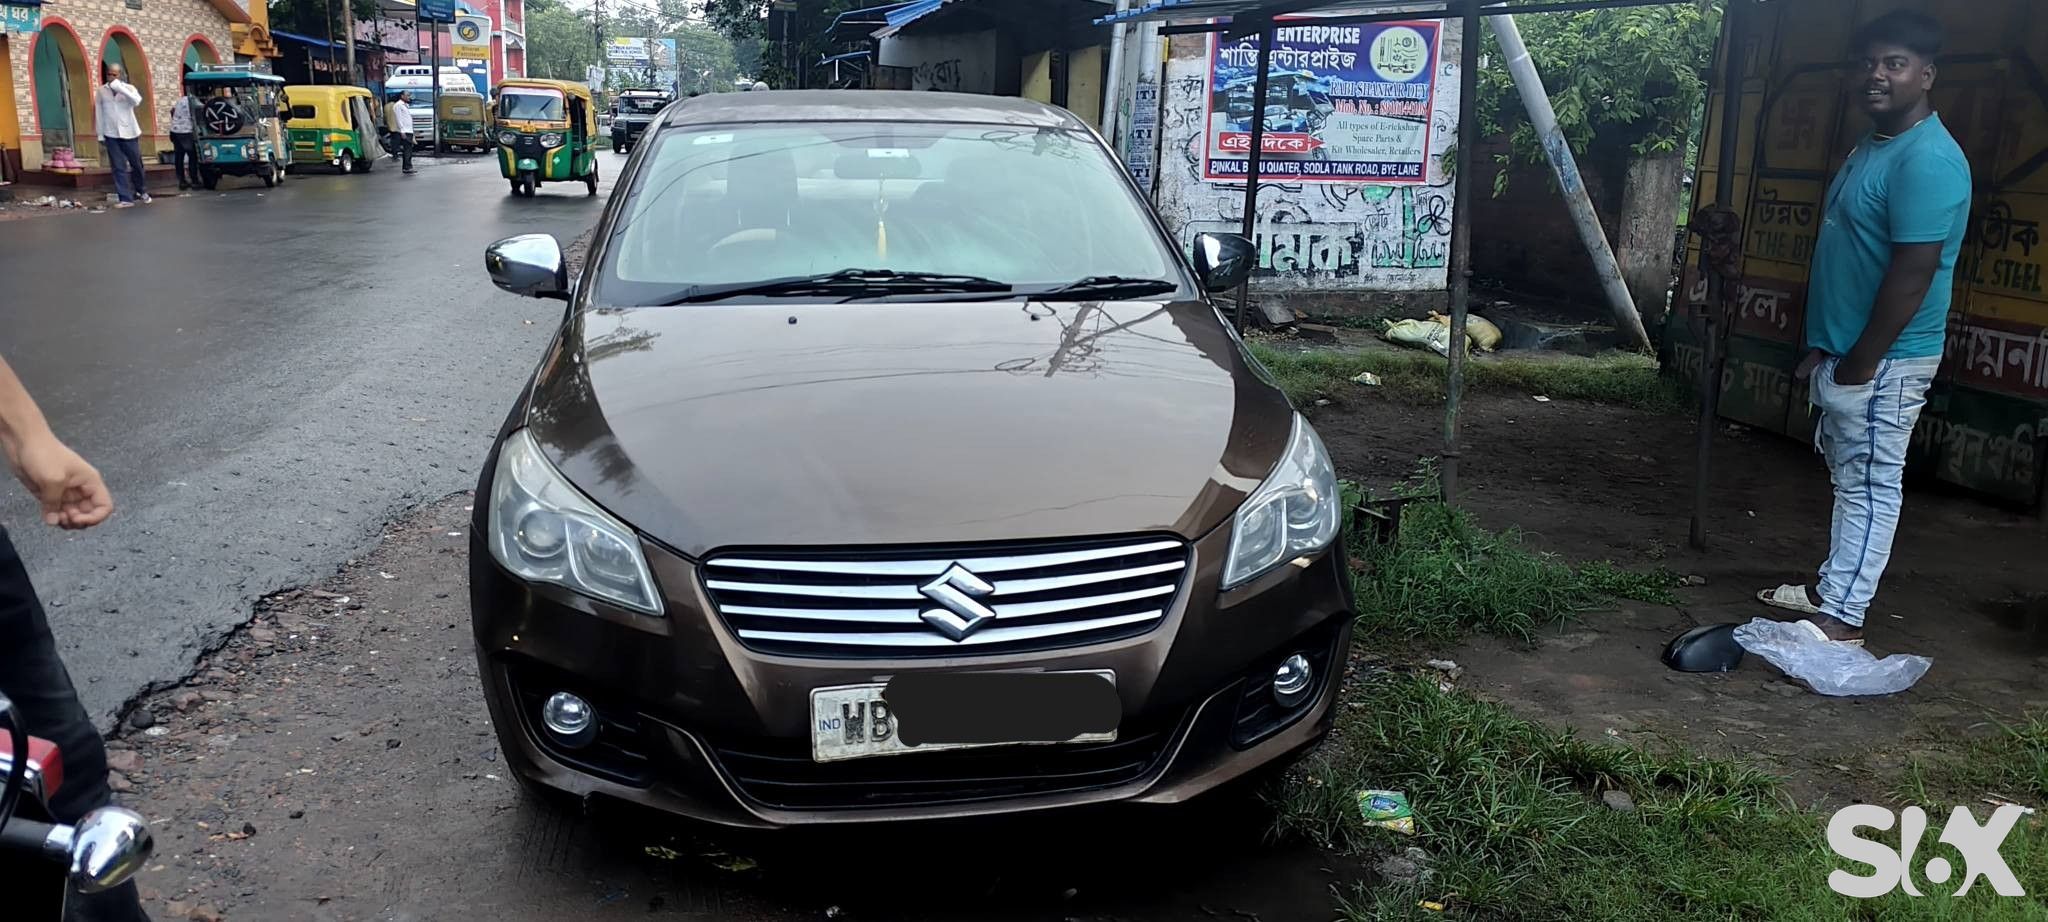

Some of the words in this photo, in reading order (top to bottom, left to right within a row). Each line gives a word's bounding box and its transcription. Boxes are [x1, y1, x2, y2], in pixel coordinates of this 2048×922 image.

[1277, 26, 1361, 45] ENTERPRISE
[1220, 43, 1260, 67] শান্তি
[1357, 82, 1405, 98] SHANKAR
[1337, 120, 1348, 130] All
[1350, 122, 1368, 132] types
[1370, 121, 1378, 130] of
[1380, 122, 1420, 132] E-rickshaw
[1352, 134, 1374, 144] Spare
[1376, 134, 1394, 143] Parts
[1211, 160, 1242, 174] PINKAL
[1303, 163, 1330, 174] SODLA
[1332, 163, 1354, 175] TANK
[1380, 164, 1397, 175] BYE
[1398, 164, 1419, 176] LANE
[1755, 230, 1785, 256] THE
[1990, 258, 2042, 291] STEEL
[818, 718, 841, 731] IND
[842, 701, 894, 744] WB
